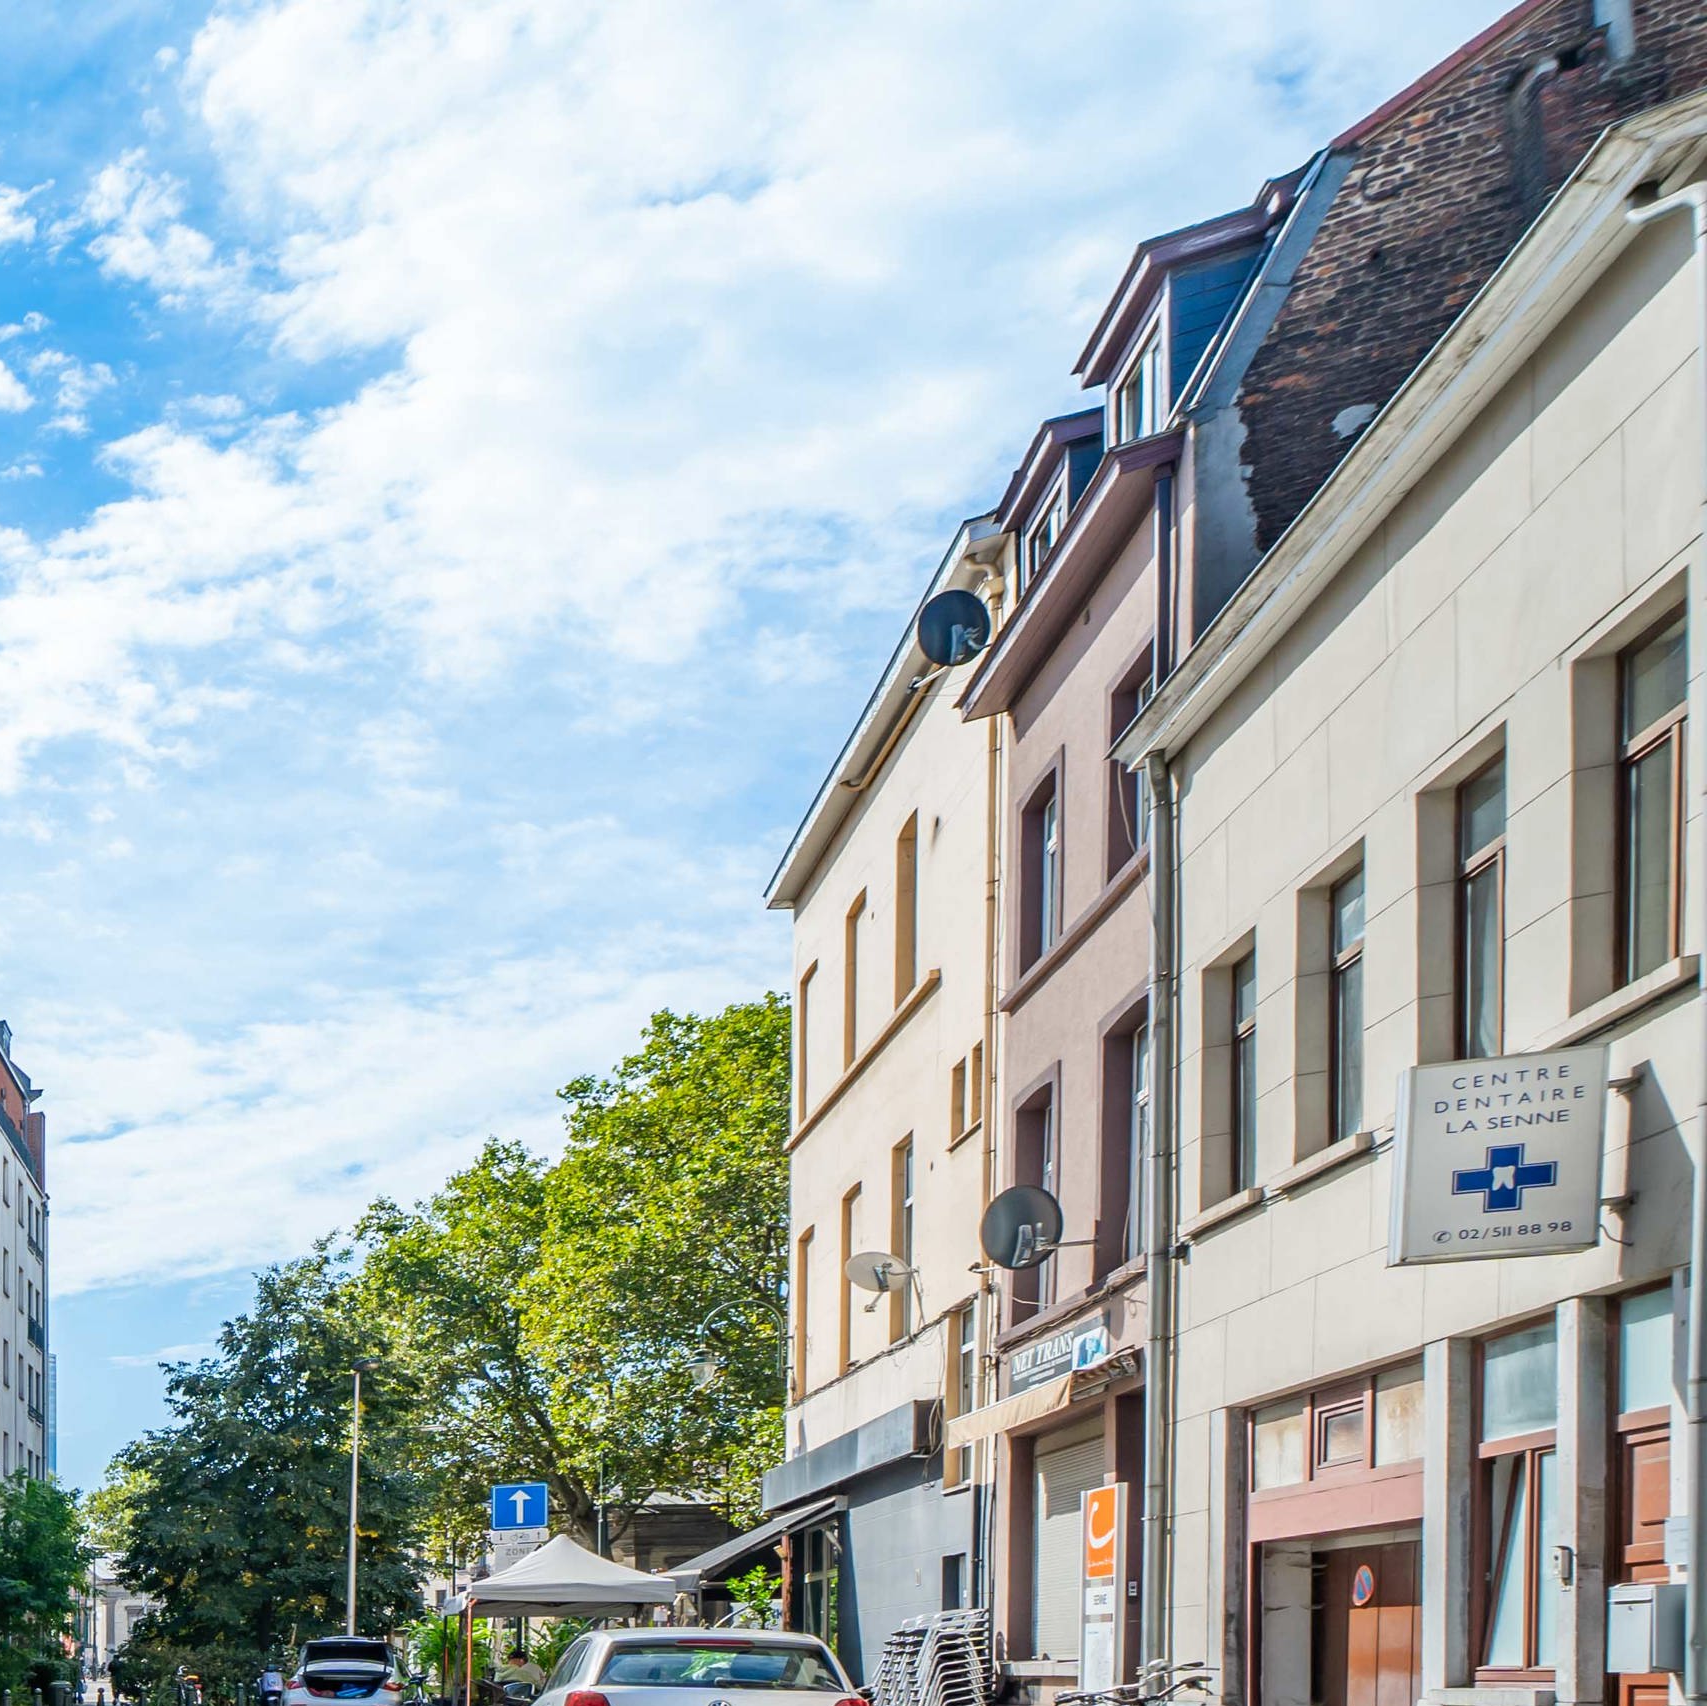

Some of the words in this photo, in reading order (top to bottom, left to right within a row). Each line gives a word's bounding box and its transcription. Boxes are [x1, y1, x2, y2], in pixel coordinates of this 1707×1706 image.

[1452, 1065, 1570, 1090] CENTRE
[1434, 1085, 1585, 1114] DENTAIRE
[1446, 1120, 1478, 1134] LA
[1487, 1109, 1570, 1130] SENNE
[1517, 1223, 1541, 1236] 88
[1547, 1221, 1572, 1233] 98
[1012, 1347, 1035, 1374] NET
[1035, 1331, 1074, 1365] TRANS
